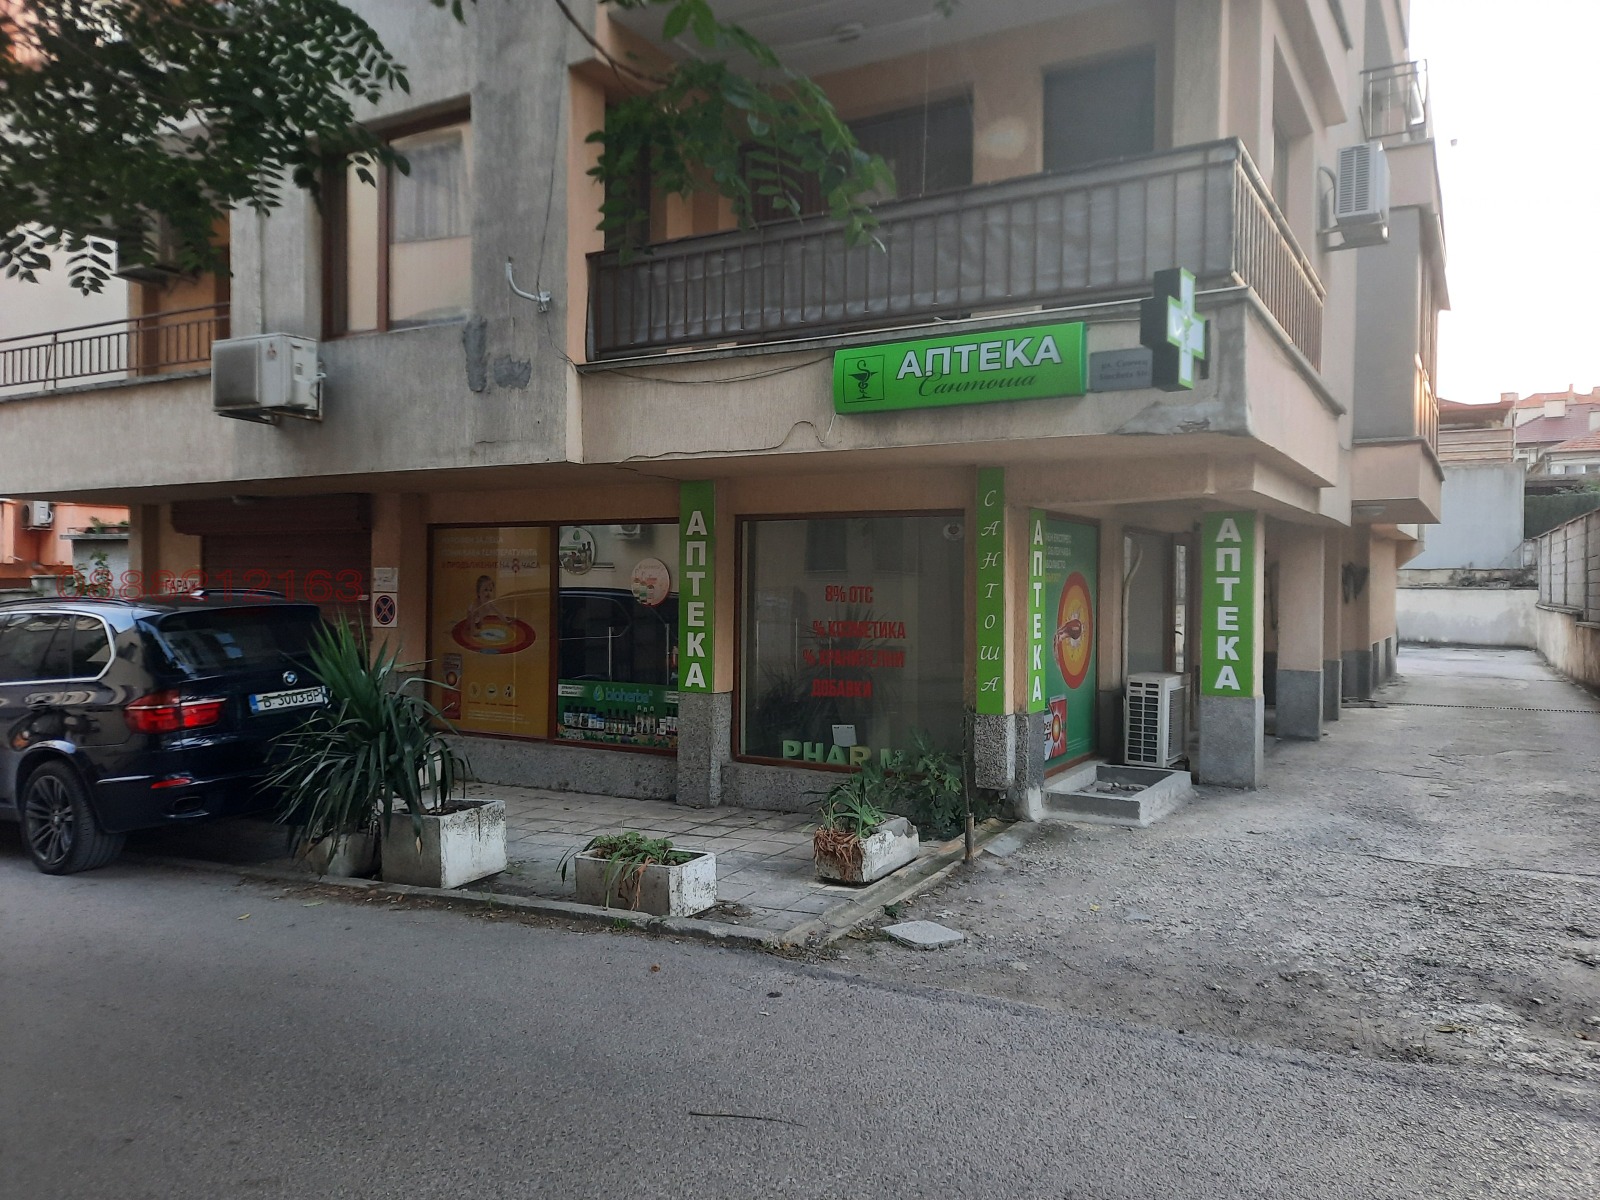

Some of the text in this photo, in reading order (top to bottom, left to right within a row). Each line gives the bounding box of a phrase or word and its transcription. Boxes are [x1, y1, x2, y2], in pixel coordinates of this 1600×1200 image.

[896, 335, 1063, 380] АПТЕКА
[918, 371, 1037, 398] Сантоша
[685, 511, 708, 688] АПТЕКА
[980, 489, 1001, 692] САНТОША
[1032, 519, 1044, 703] АПТЕКА
[1215, 518, 1242, 690] АПТЕКА
[811, 679, 874, 697] ДОБАВКИ
